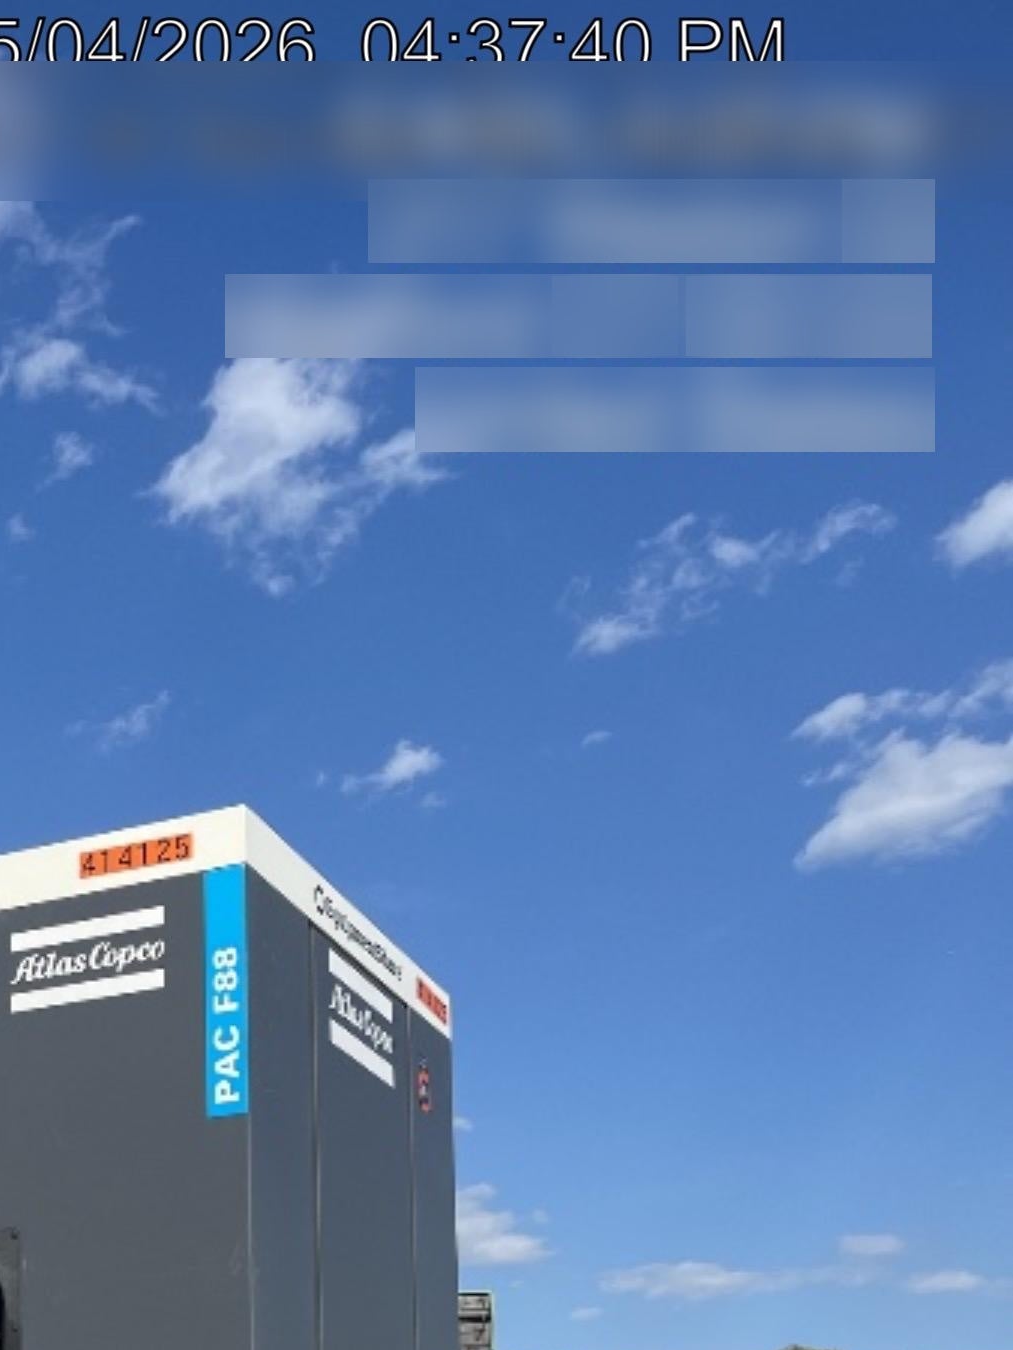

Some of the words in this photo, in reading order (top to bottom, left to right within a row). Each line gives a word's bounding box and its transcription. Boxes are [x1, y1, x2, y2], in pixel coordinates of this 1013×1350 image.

[10, 951, 88, 985] Atlas
[88, 939, 166, 973] Copco
[212, 946, 239, 1015] F88
[213, 1024, 240, 1105] PAC
